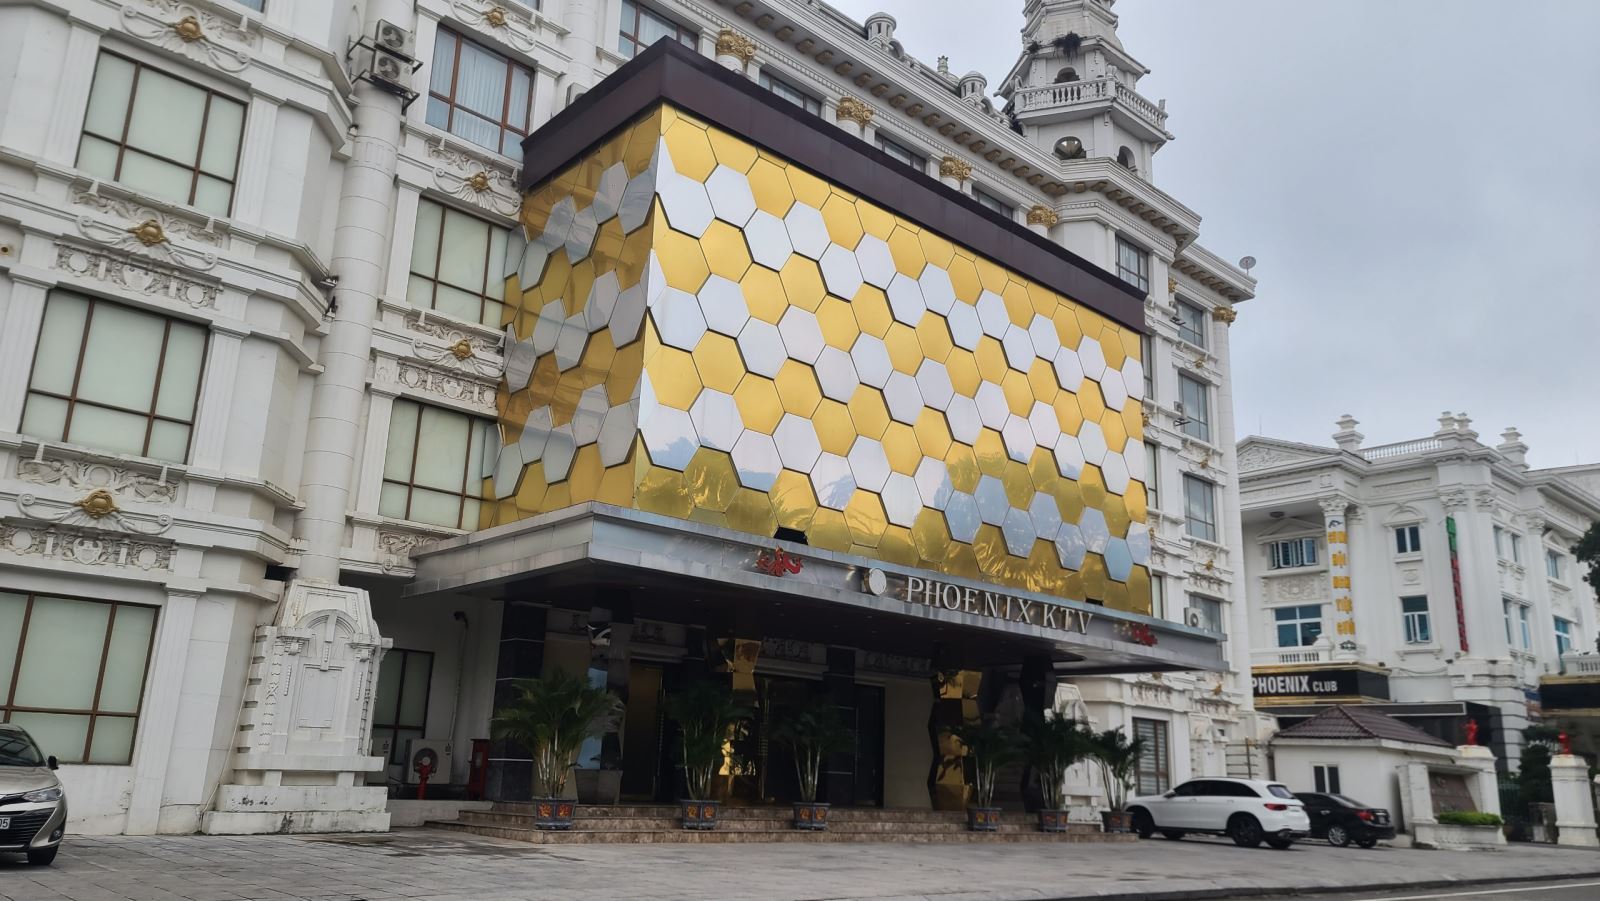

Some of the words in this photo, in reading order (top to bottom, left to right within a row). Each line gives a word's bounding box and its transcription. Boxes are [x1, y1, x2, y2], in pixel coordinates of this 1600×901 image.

[906, 576, 1032, 625] PHOENIX
[1042, 603, 1093, 635] KTV
[1312, 680, 1338, 692] CLUB
